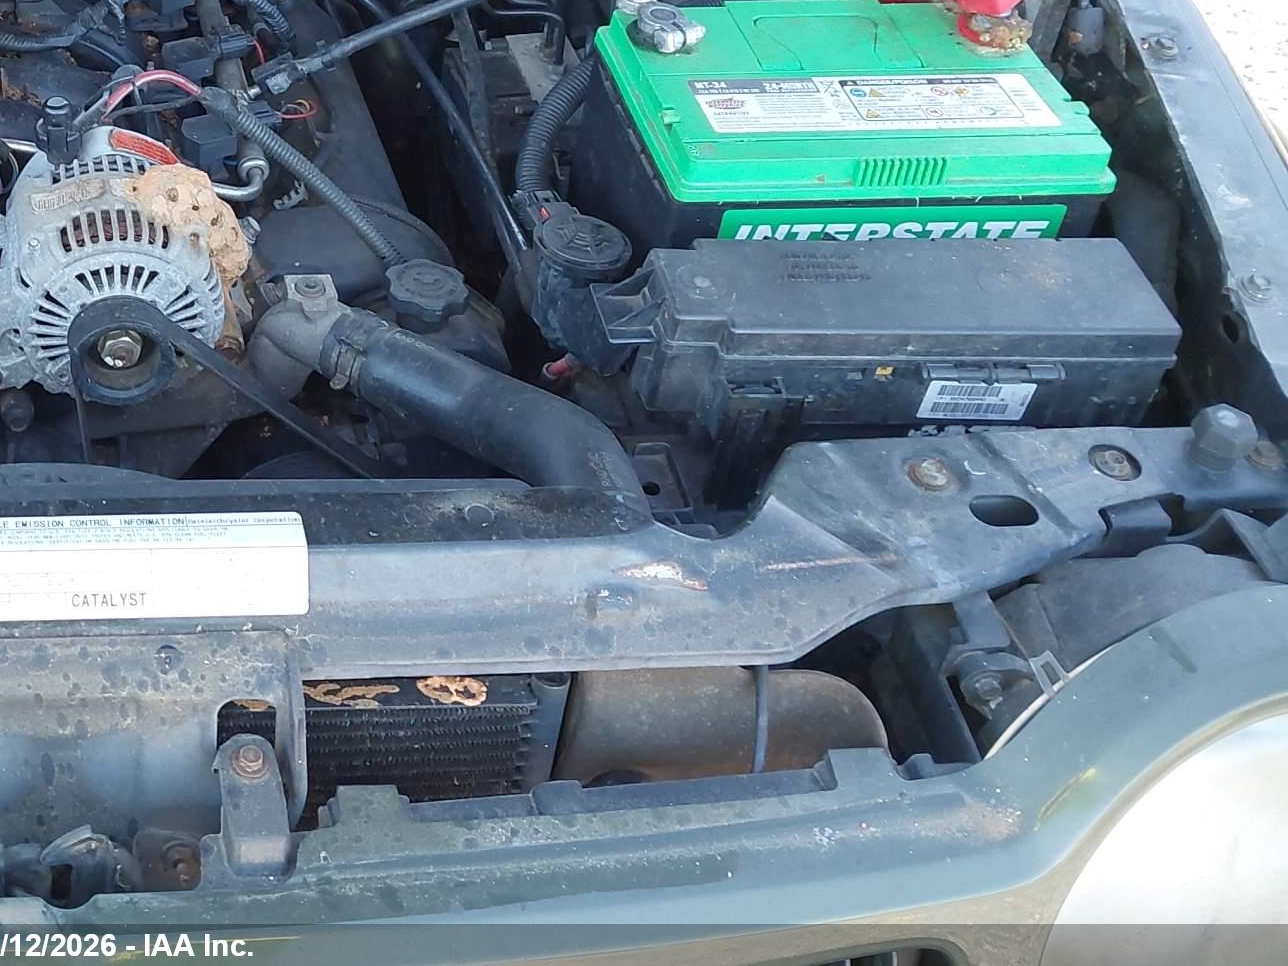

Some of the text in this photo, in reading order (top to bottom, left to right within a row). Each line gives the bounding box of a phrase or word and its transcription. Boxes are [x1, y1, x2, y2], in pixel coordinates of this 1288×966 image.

[15, 520, 64, 528] EMISSION
[70, 519, 112, 527] CONTROL
[119, 518, 185, 527] INFORMATION
[71, 592, 146, 608] CATALYST
